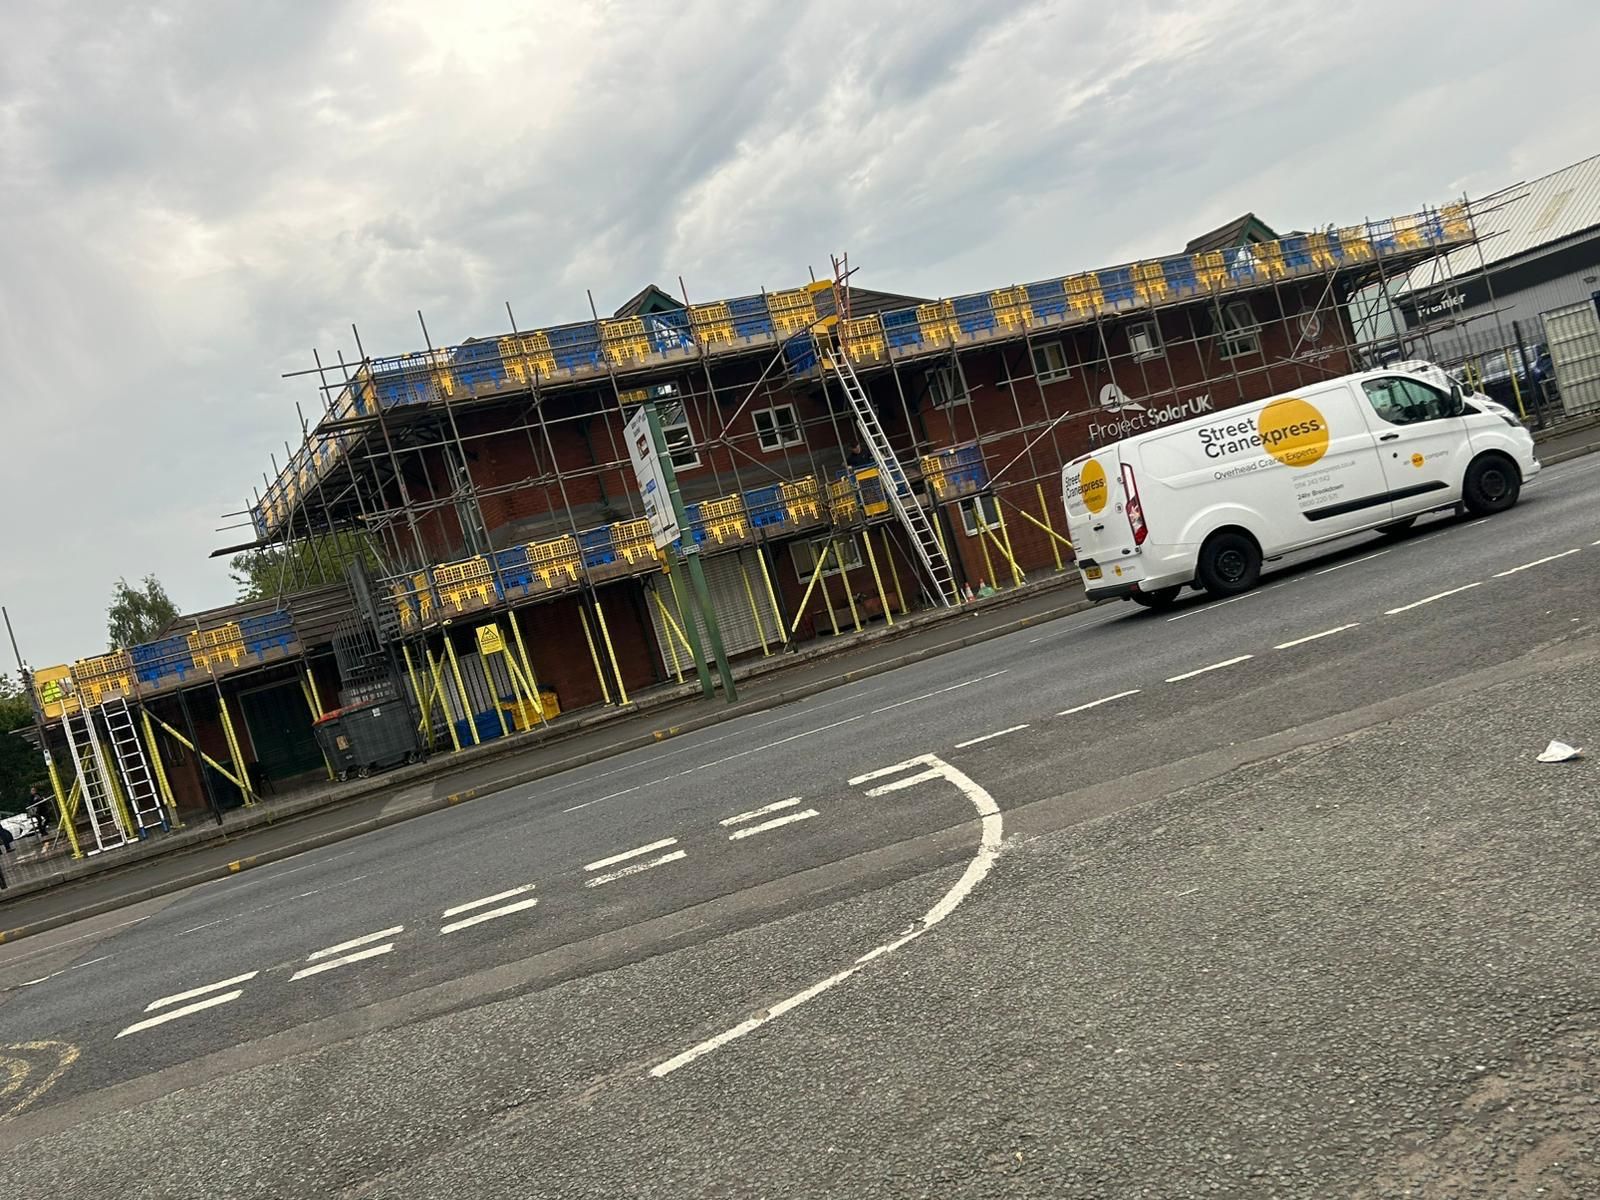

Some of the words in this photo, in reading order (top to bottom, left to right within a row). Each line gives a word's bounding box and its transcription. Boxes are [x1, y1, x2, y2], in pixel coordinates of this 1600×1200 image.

[1088, 412, 1148, 441] Project
[1147, 404, 1188, 425] Solar
[1188, 394, 1213, 414] UK
[1198, 418, 1257, 444] Street
[1213, 462, 1258, 480] Overhead
[1258, 455, 1285, 468] Crane
[1285, 446, 1318, 461] Experts
[1065, 472, 1081, 488] Street
[1311, 483, 1344, 497] Breakdown
